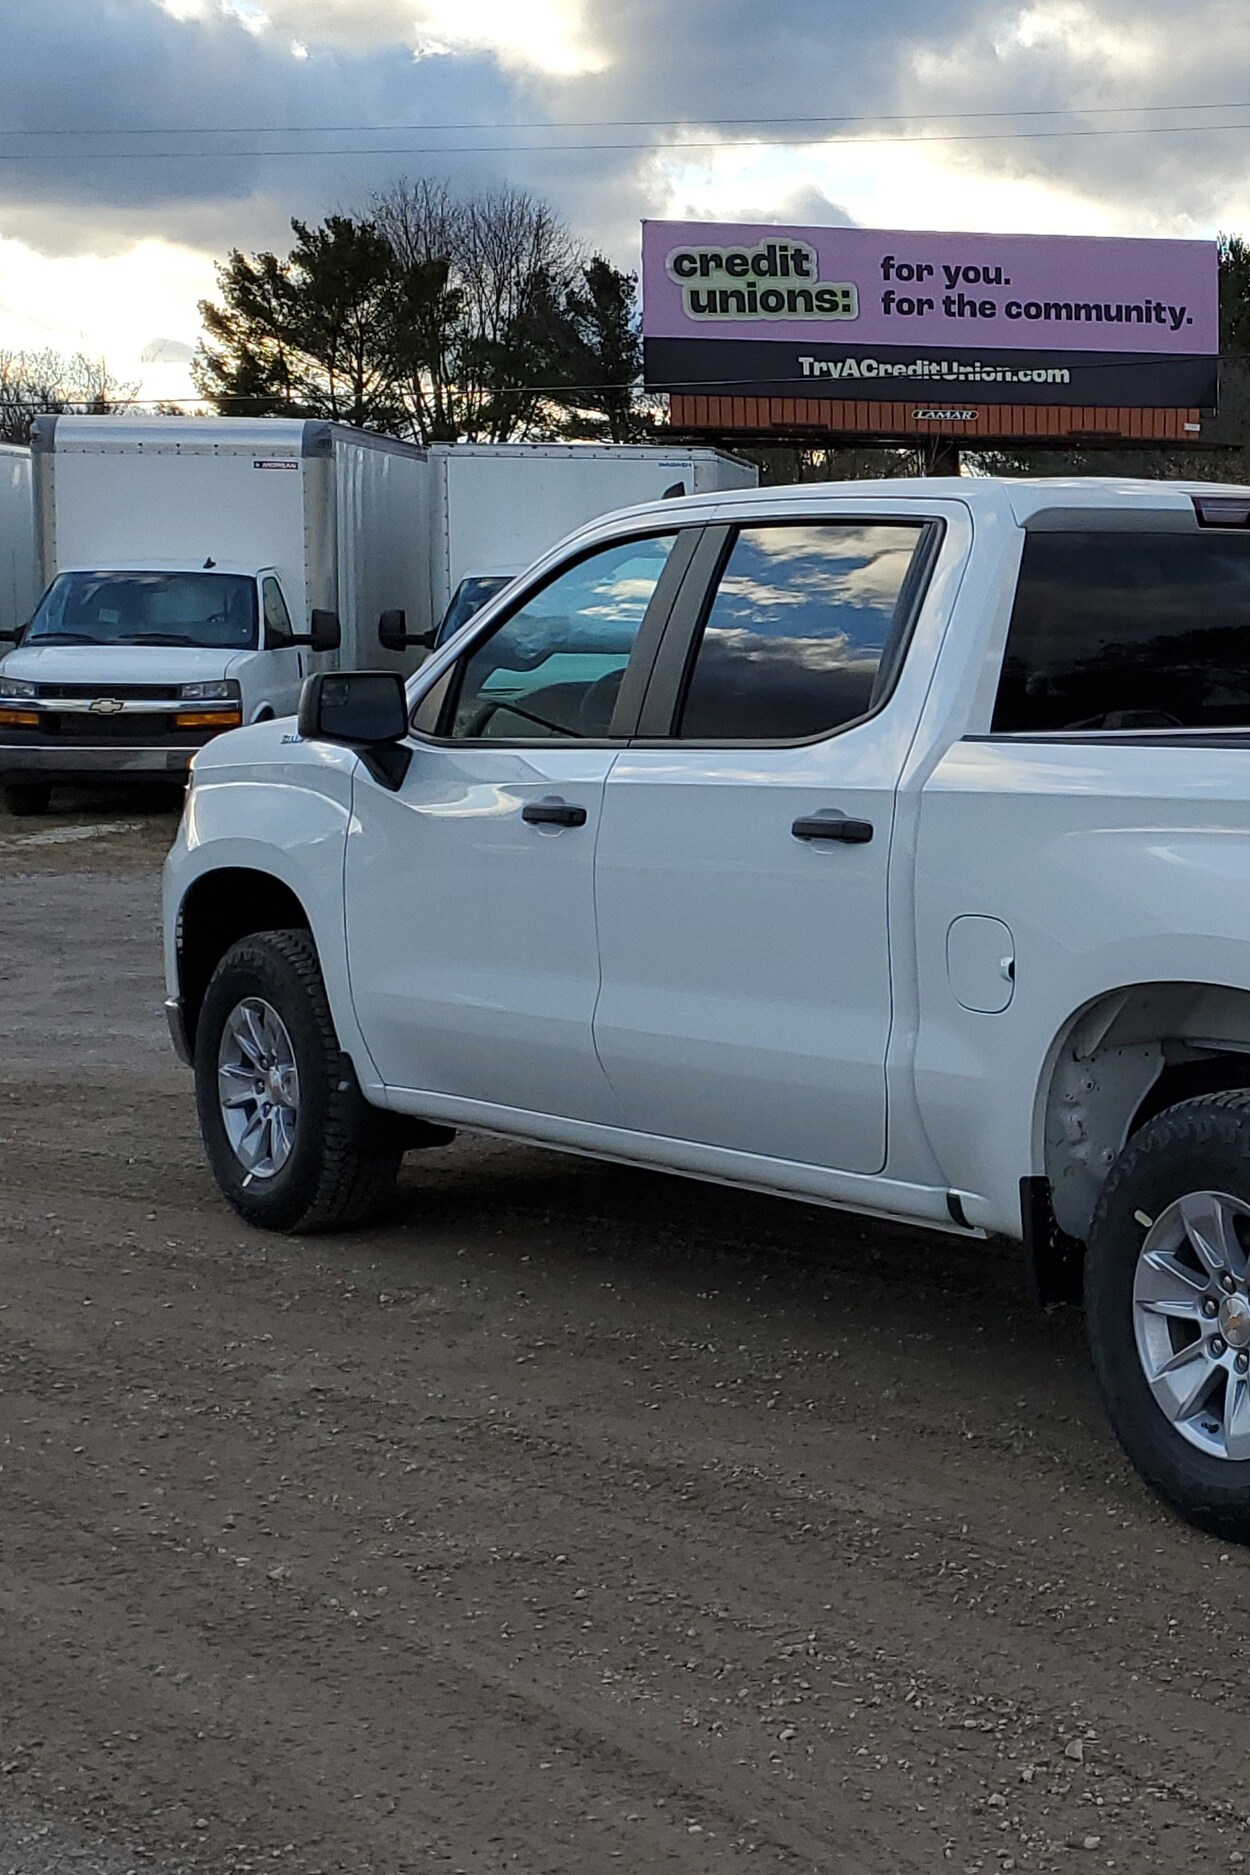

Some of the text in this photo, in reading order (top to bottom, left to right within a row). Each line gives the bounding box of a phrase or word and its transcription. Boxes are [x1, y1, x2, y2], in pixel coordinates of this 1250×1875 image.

[673, 244, 810, 277] credit
[880, 256, 1011, 290] for you.
[690, 281, 850, 313] unions:
[881, 290, 1194, 331] for the community.
[798, 356, 1071, 384] TryACreditUnion.com
[916, 410, 972, 420] LAMAR
